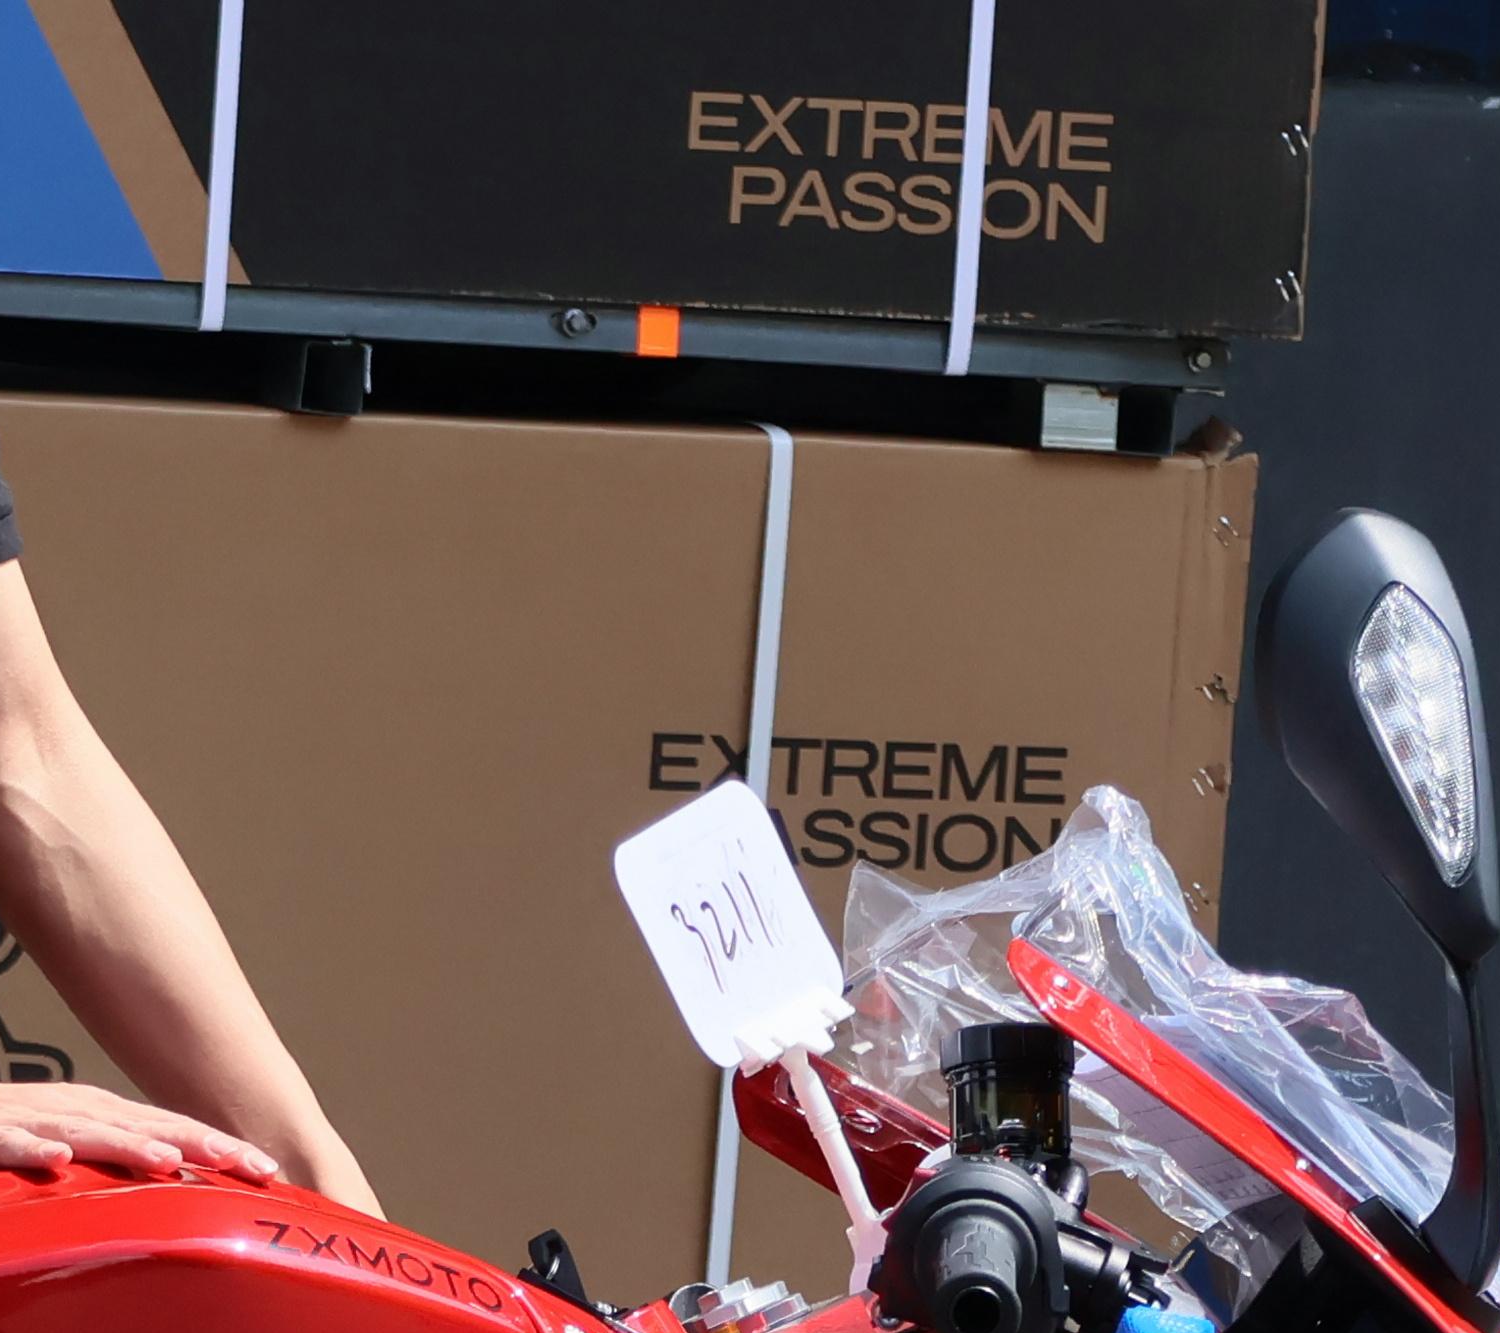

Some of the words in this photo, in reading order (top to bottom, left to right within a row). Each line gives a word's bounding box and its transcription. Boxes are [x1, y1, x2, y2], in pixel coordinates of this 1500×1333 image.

[686, 91, 1115, 174] EXTREME
[727, 165, 1109, 244] PASSON
[255, 1219, 504, 1313] ZXMOTO
